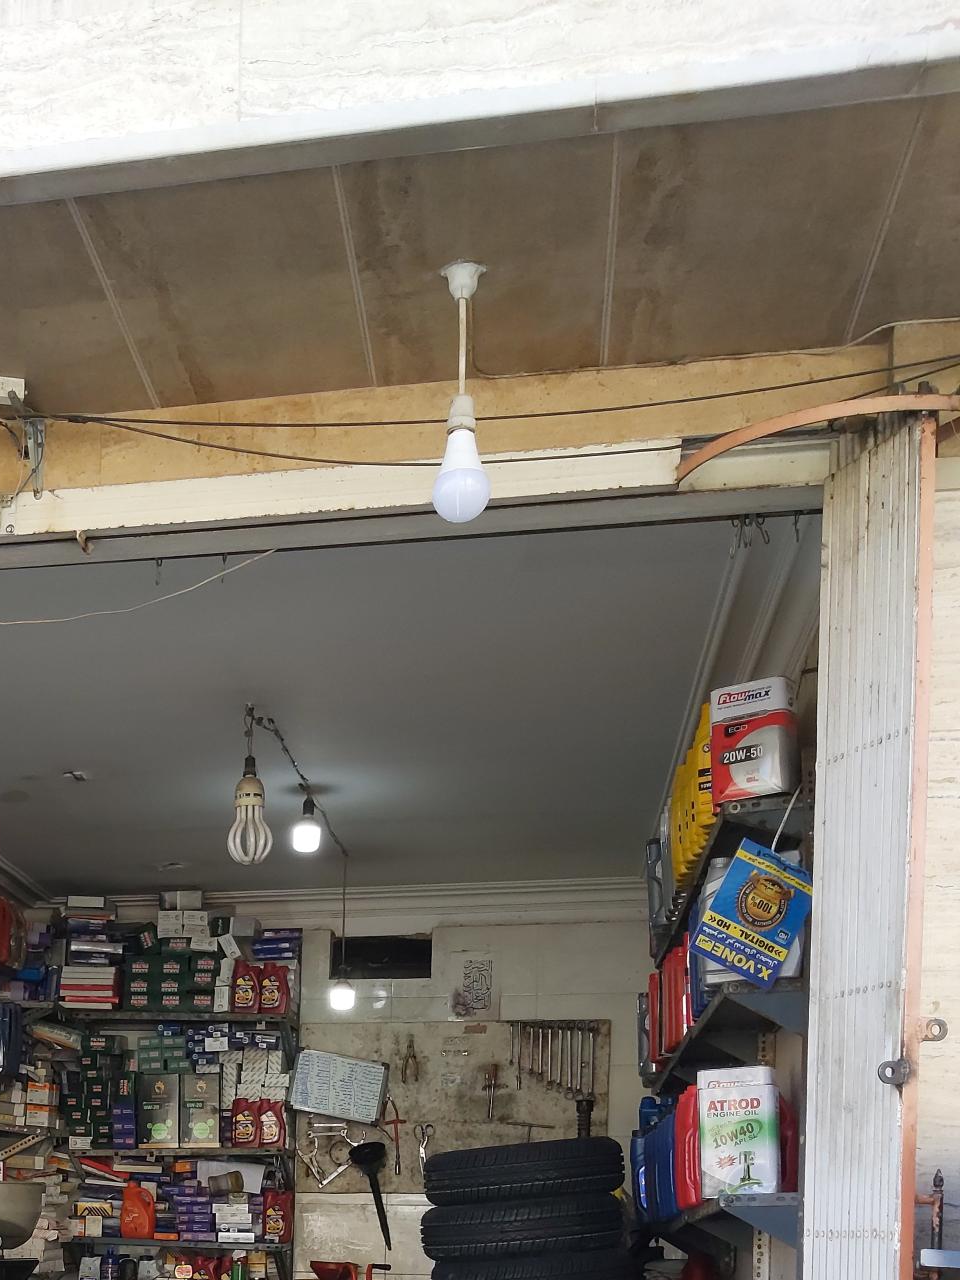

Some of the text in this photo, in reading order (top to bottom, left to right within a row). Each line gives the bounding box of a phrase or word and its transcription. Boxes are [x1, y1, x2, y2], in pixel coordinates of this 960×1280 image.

[723, 746, 763, 763] 20W-50
[751, 896, 773, 914] 100%
[740, 929, 777, 953] DIGITAL
[712, 943, 773, 981] X.VONE
[707, 1098, 760, 1112] ATROD
[713, 1123, 754, 1149] 10W40
